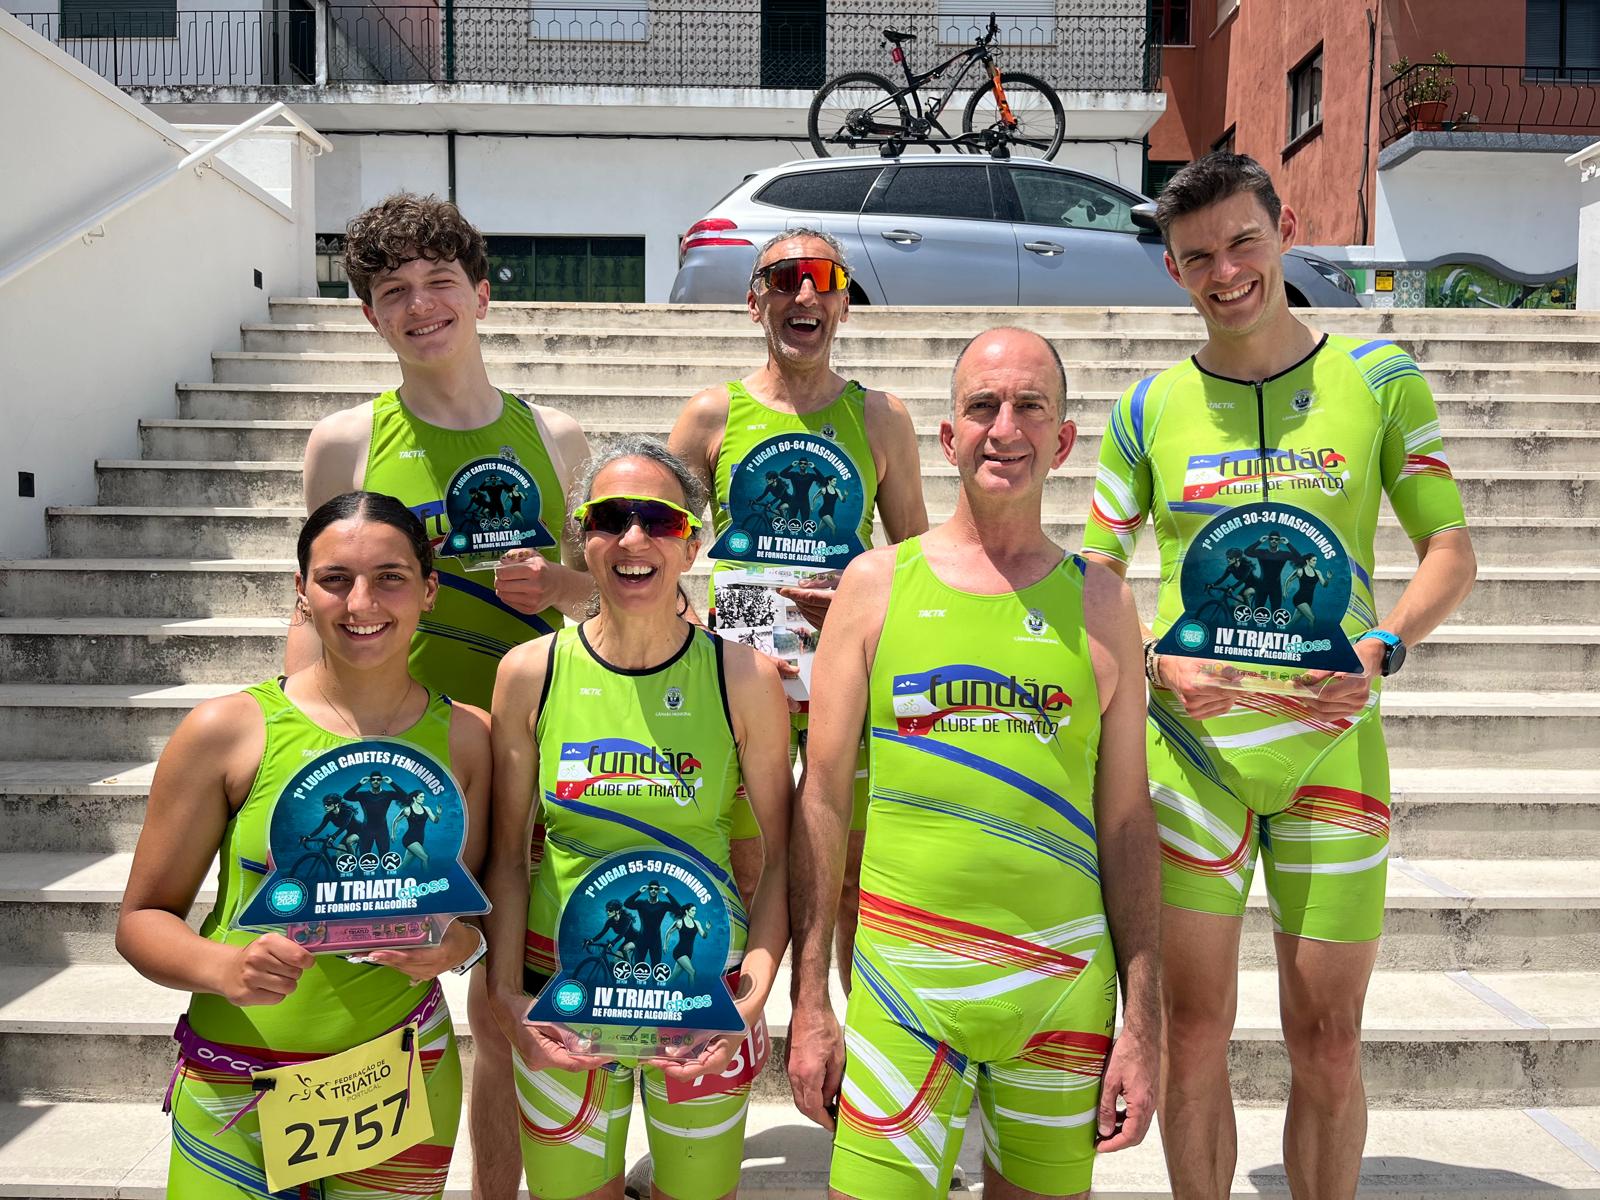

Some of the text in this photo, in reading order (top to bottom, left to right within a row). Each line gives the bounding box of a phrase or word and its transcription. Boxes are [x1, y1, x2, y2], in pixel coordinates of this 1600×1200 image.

[754, 445, 779, 468] LUGAR
[778, 440, 805, 453] 60-64
[806, 441, 851, 481] MASCULINOS
[1219, 447, 1338, 477] fundão
[457, 471, 472, 492] LUGAR
[470, 463, 497, 475] CADETES
[497, 463, 531, 489] MASCULINOS
[1218, 477, 1344, 496] CLUBE DE TRIATLO
[472, 533, 484, 544] IV
[758, 535, 773, 550] IV
[1209, 517, 1243, 543] LUGAR
[1243, 511, 1277, 525] 30-34
[1278, 512, 1336, 560] MASCULINOS
[796, 554, 826, 563] ALGODRES
[1215, 627, 1234, 645] IV
[1285, 639, 1332, 654] CROSS
[1214, 646, 1223, 654] DE
[1224, 647, 1253, 657] FORNOS
[1264, 650, 1302, 662] ALGODRES
[930, 674, 1063, 711] fundão
[933, 718, 1059, 735] CLUBE DE TRIATLO
[587, 745, 694, 775] fundão
[293, 751, 445, 800] 1º LUGAR CADETES FEMININOS
[584, 783, 695, 799] CLUBE DE TRIATLO
[316, 881, 338, 903] IV
[398, 878, 450, 900] CROSS
[584, 860, 712, 905] 1º LUGAR 55-59 FEMININOS
[315, 898, 418, 914] DE FORNOS DE ALGODRES
[593, 986, 613, 1007] IV
[665, 995, 713, 1012] CROSS
[592, 1007, 683, 1021] DE FORNOS DE ALGODRES
[331, 1064, 391, 1099] TRIATLO
[335, 1059, 386, 1085] FEDERAÇÃO DE
[347, 1084, 382, 1101] PORTUGAL
[284, 1088, 408, 1166] 2757
